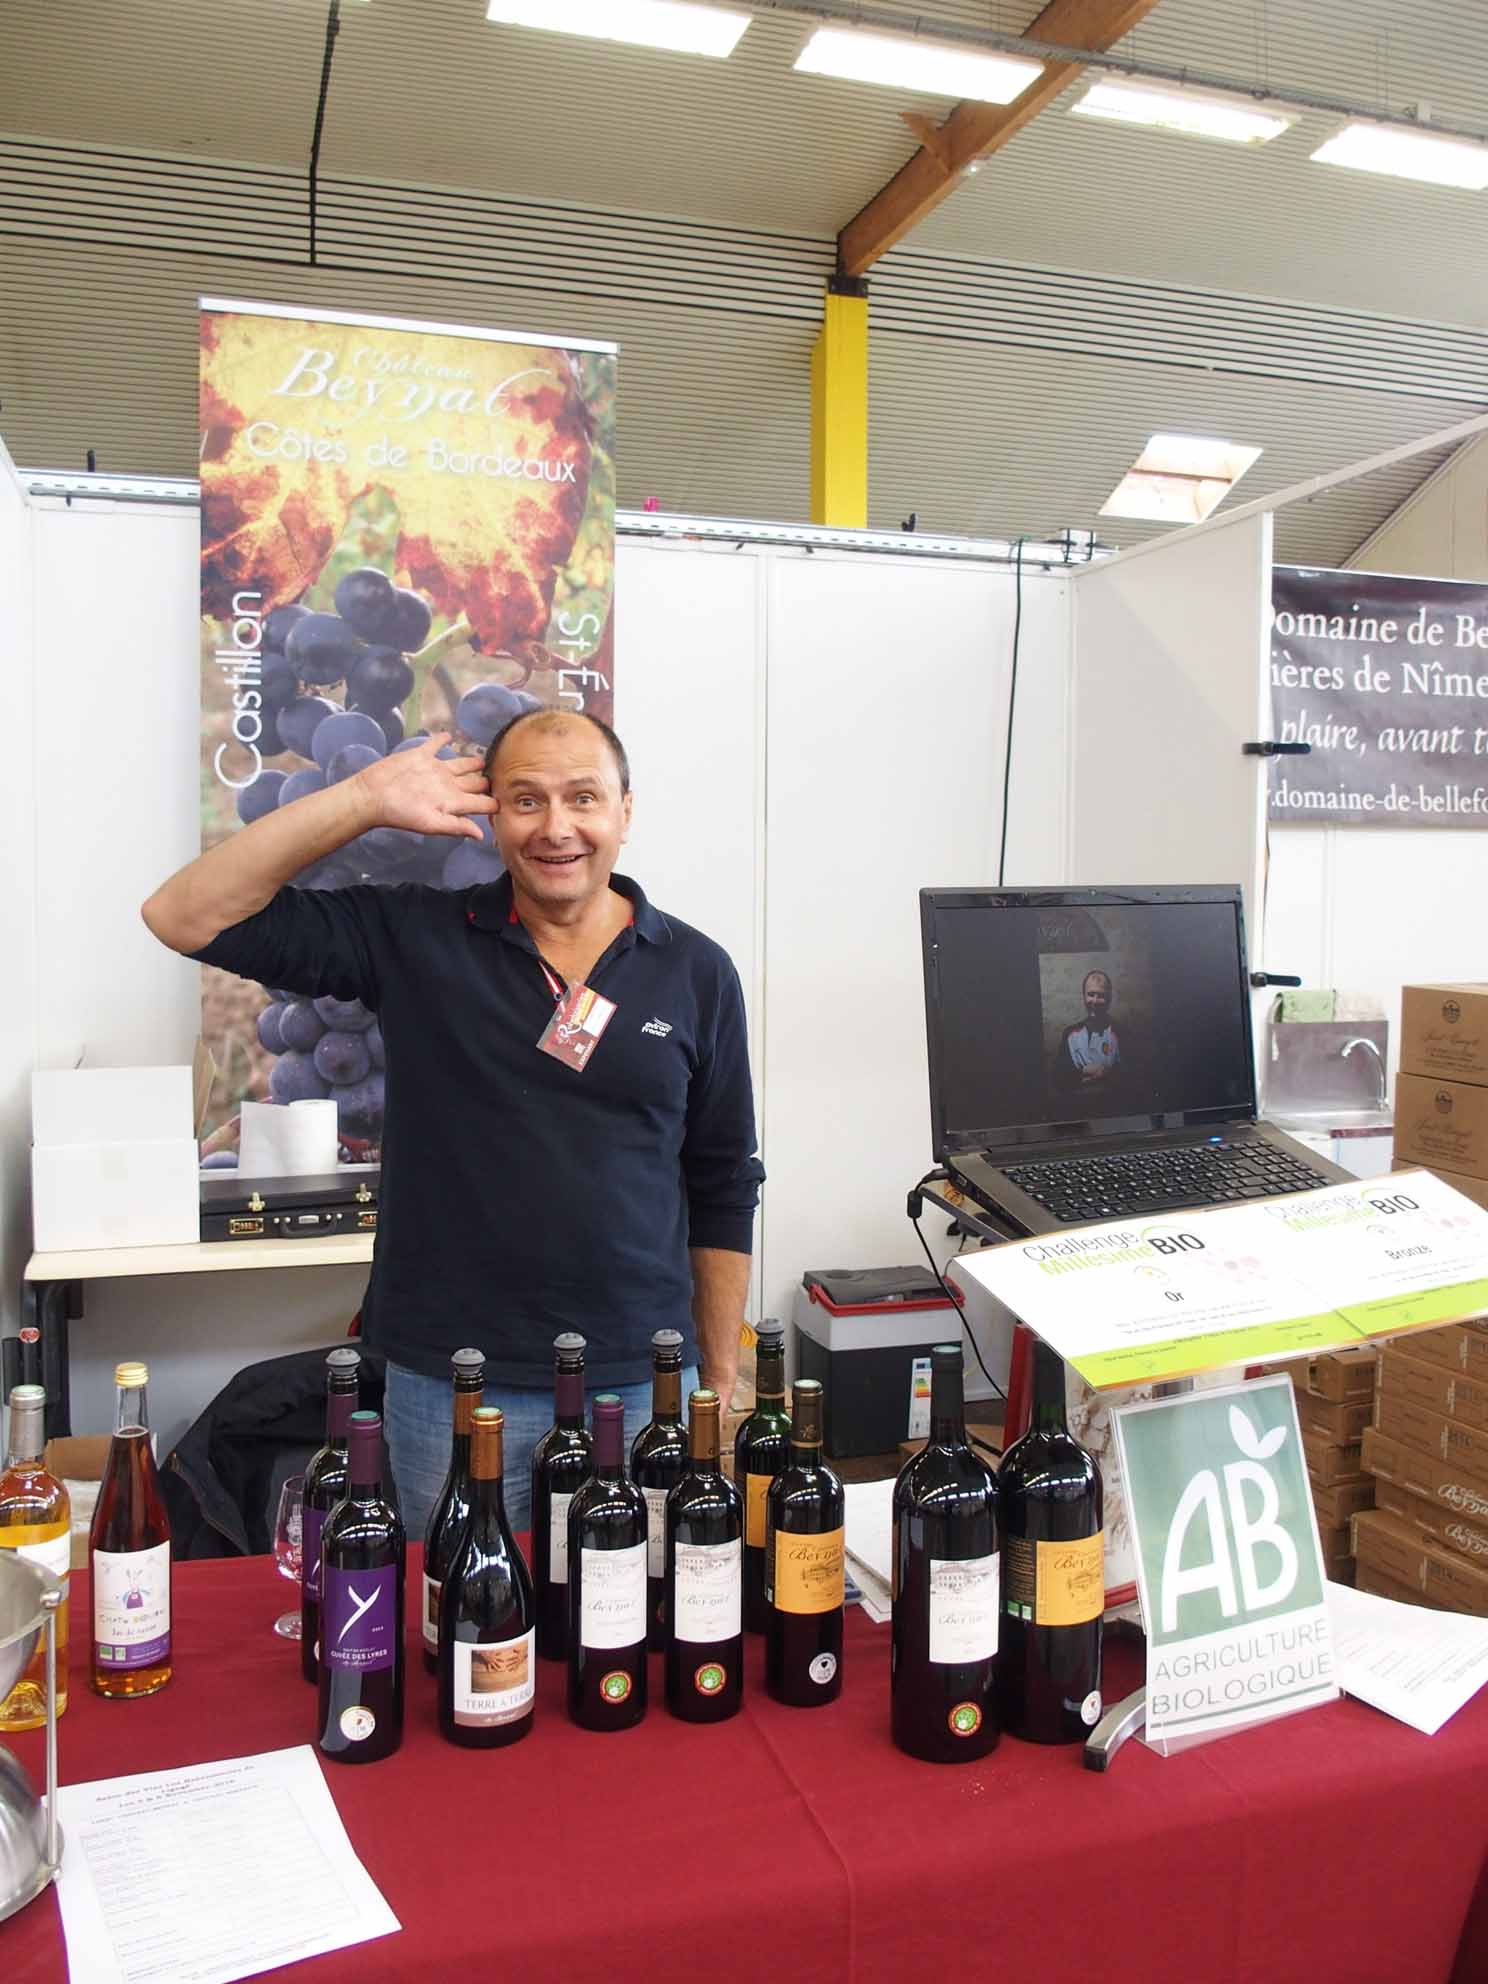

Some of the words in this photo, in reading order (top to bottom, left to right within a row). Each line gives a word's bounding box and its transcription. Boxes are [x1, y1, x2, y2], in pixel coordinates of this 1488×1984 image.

[270, 346, 552, 423] Beynal
[246, 420, 347, 464] Côtes
[366, 434, 407, 467] de
[427, 437, 577, 483] Bordeaux
[1271, 603, 1398, 644] omaine
[1406, 606, 1444, 646] de
[1455, 614, 1488, 649] Be
[214, 590, 262, 789] Castillon
[1354, 654, 1391, 693] de
[1377, 724, 1465, 754] avant
[1369, 1194, 1420, 1215] BIO
[1023, 1231, 1140, 1263] Challenge
[1148, 1233, 1206, 1255] BIO
[1163, 1290, 1185, 1302] Or
[1161, 1459, 1299, 1633] AB
[1155, 1618, 1328, 1682] AGRICULTURE
[1151, 1652, 1332, 1716] BIOLOGIQUE
